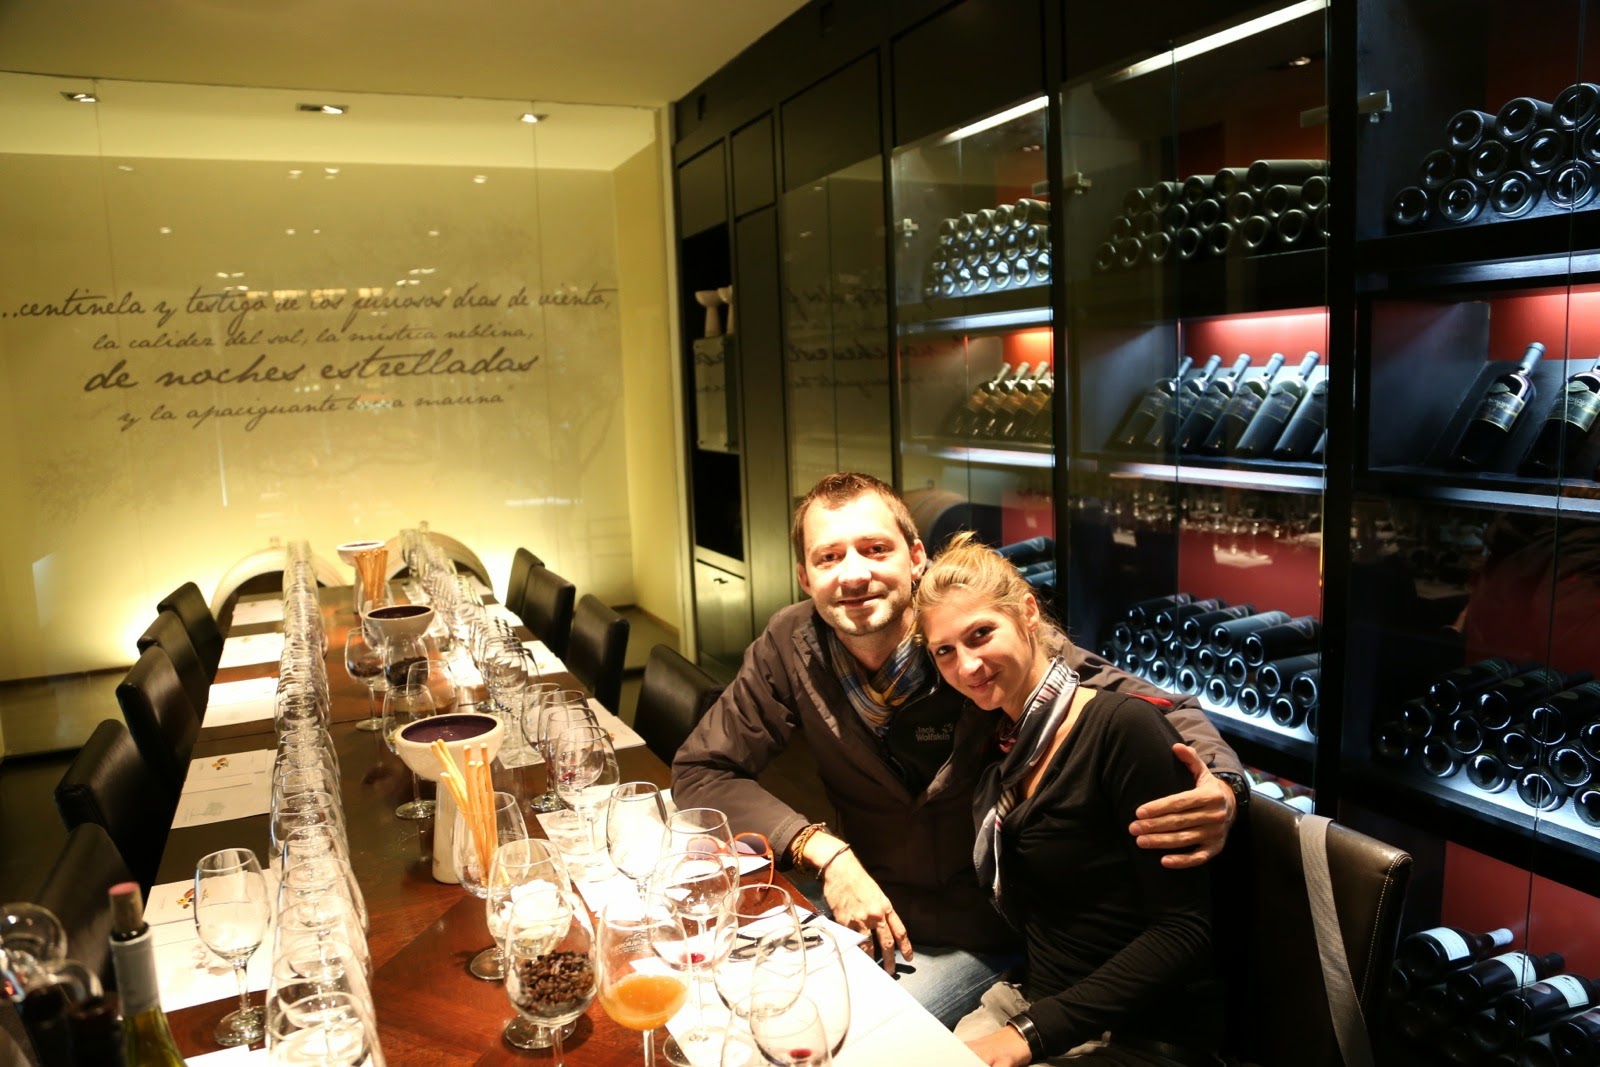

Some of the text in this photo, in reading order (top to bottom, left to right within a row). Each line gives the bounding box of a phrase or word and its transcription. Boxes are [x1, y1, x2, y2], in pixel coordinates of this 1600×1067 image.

[154, 301, 178, 328] y
[186, 287, 268, 336] testigo
[507, 286, 530, 308] de
[93, 333, 120, 351] la
[129, 330, 216, 349] calidez
[225, 330, 259, 348] del
[267, 328, 308, 347] sol,
[316, 327, 340, 342] la
[444, 321, 534, 340] neblina,
[84, 345, 540, 392] de noches estrelladas
[117, 409, 143, 433] y
[150, 404, 178, 421] la
[186, 393, 352, 433] apaciguante
[915, 726, 935, 734] Jack
[915, 732, 950, 741] Wolfskin
